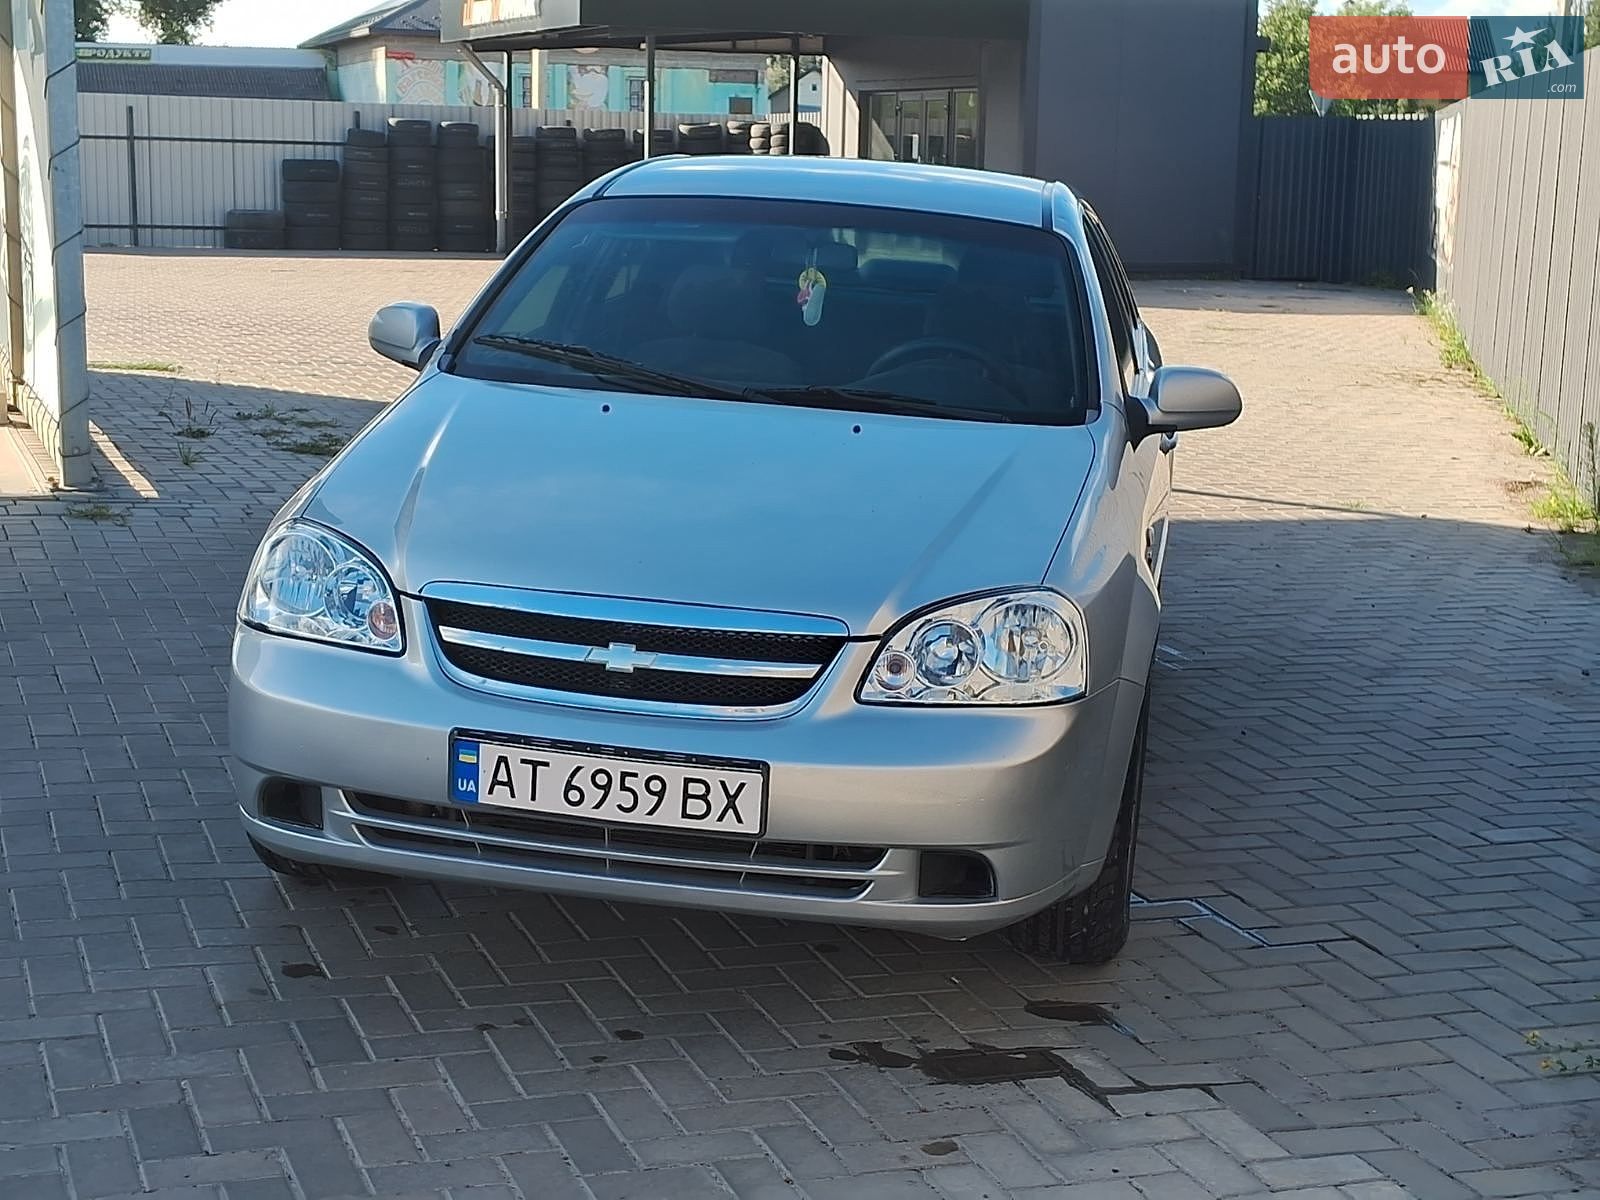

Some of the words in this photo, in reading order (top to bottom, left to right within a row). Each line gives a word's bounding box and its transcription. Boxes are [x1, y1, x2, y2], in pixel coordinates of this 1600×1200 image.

[457, 778, 477, 794] UA
[487, 755, 550, 802] AT
[562, 765, 667, 816] 6959
[680, 776, 747, 825] BX
